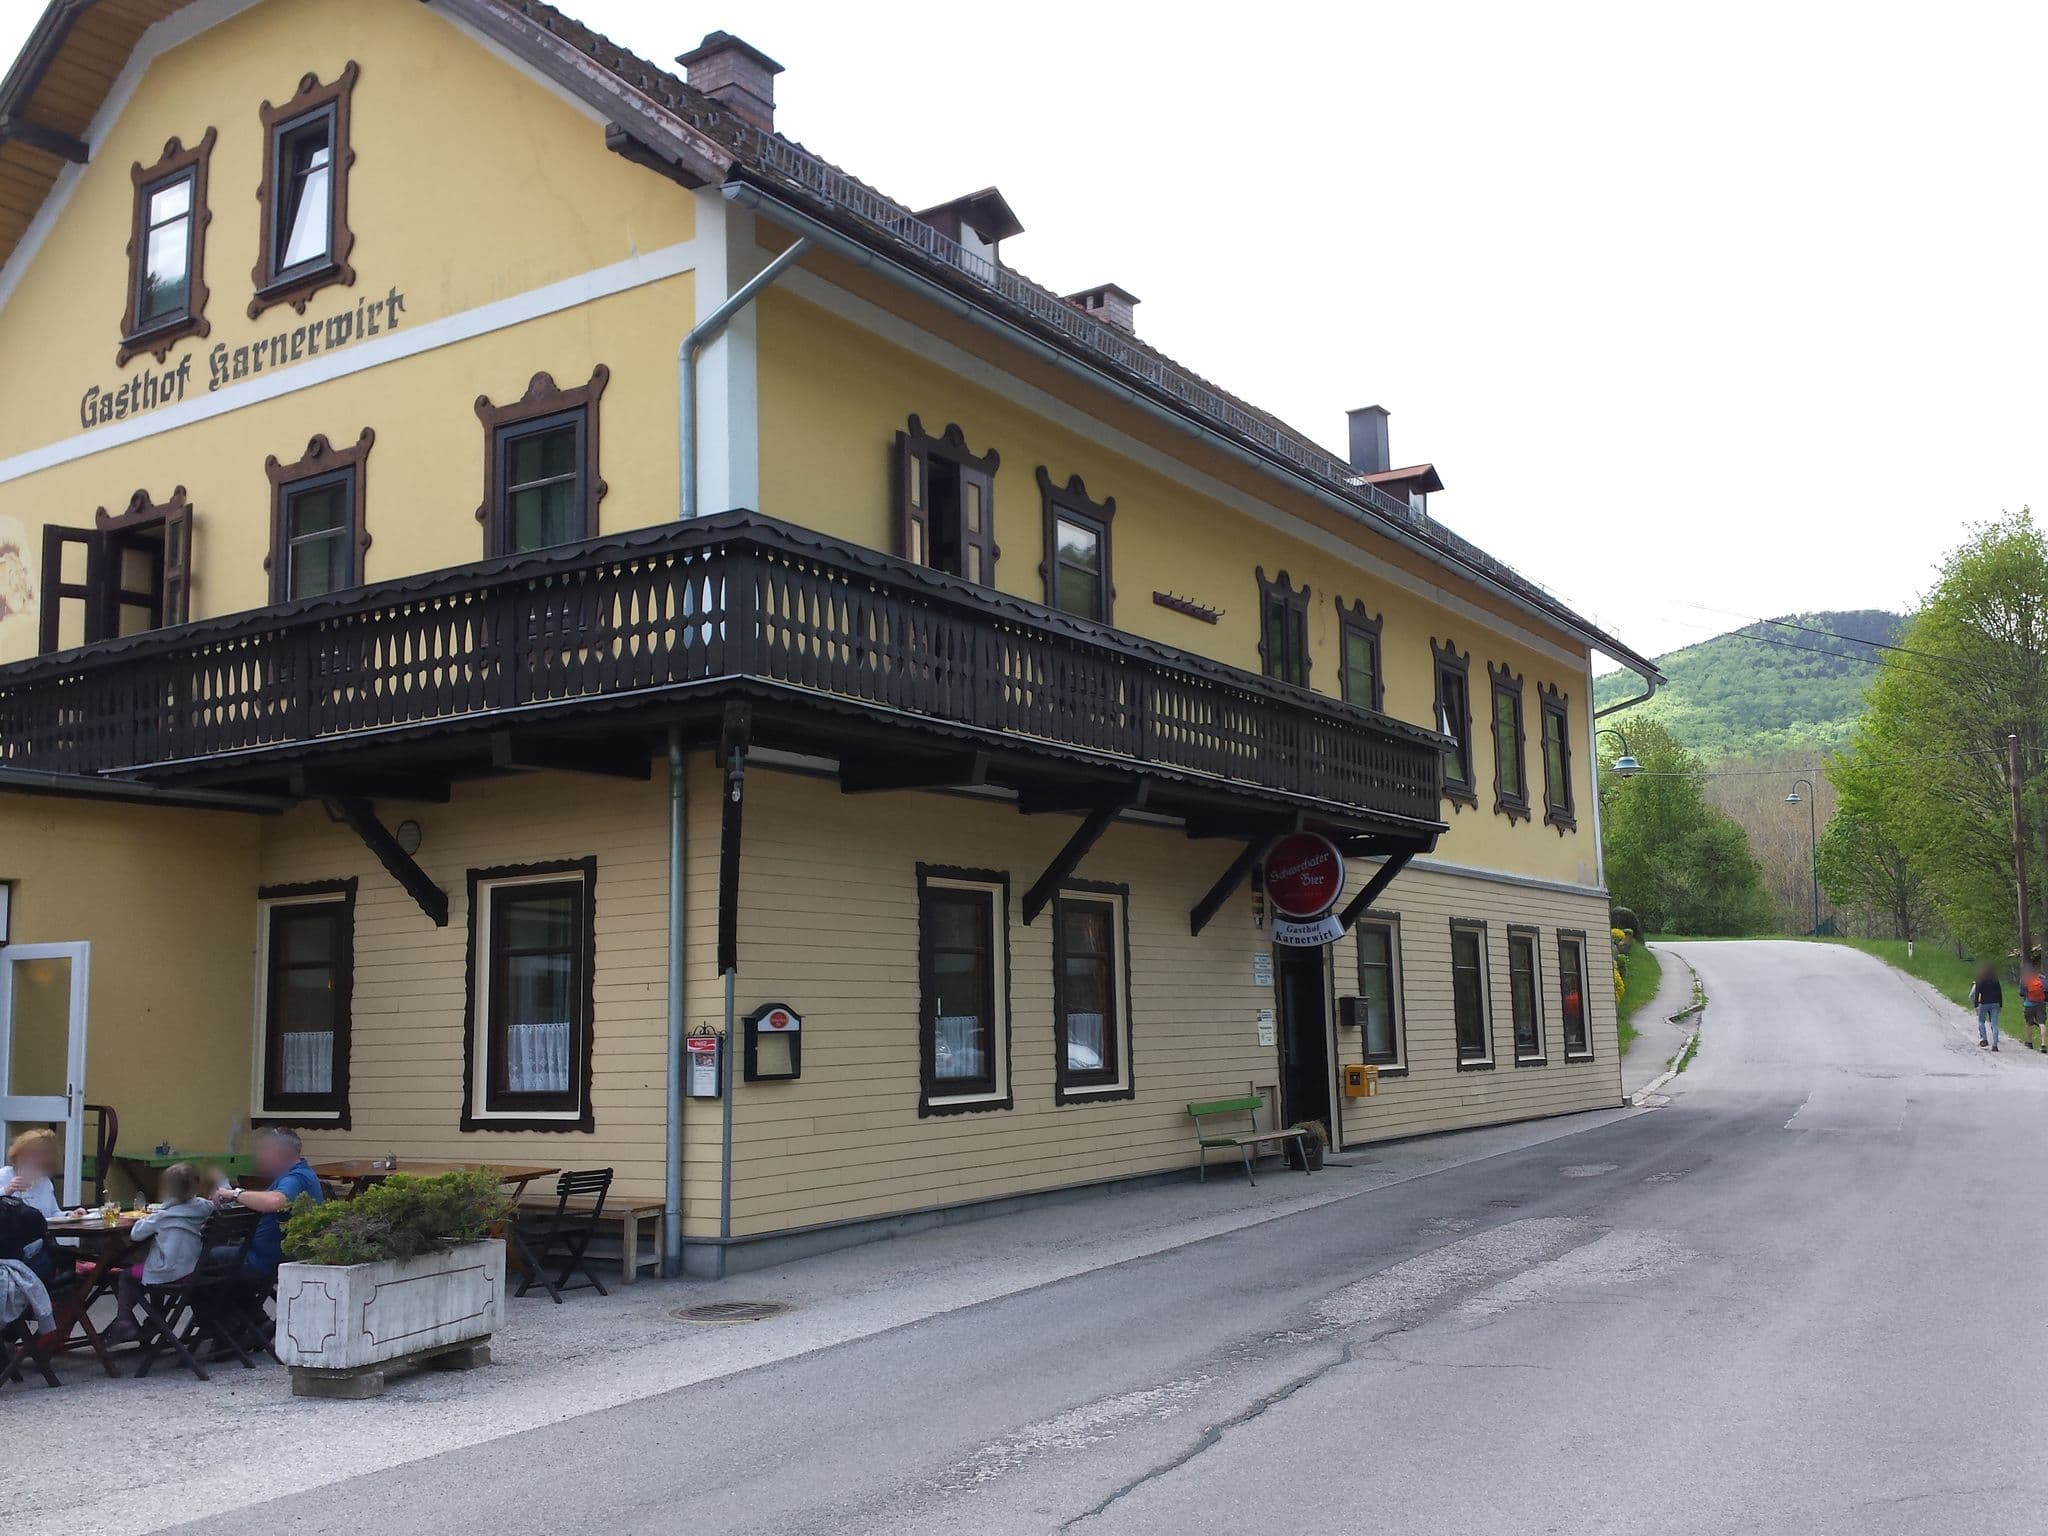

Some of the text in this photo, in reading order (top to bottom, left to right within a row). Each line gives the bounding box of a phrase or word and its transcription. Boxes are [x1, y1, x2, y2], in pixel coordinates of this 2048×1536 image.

[80, 286, 406, 429] Gasthof Karnerwirt
[1301, 872, 1325, 887] Bier
[1286, 923, 1320, 934] Gasthof
[1275, 930, 1334, 945] Karnerwirt
